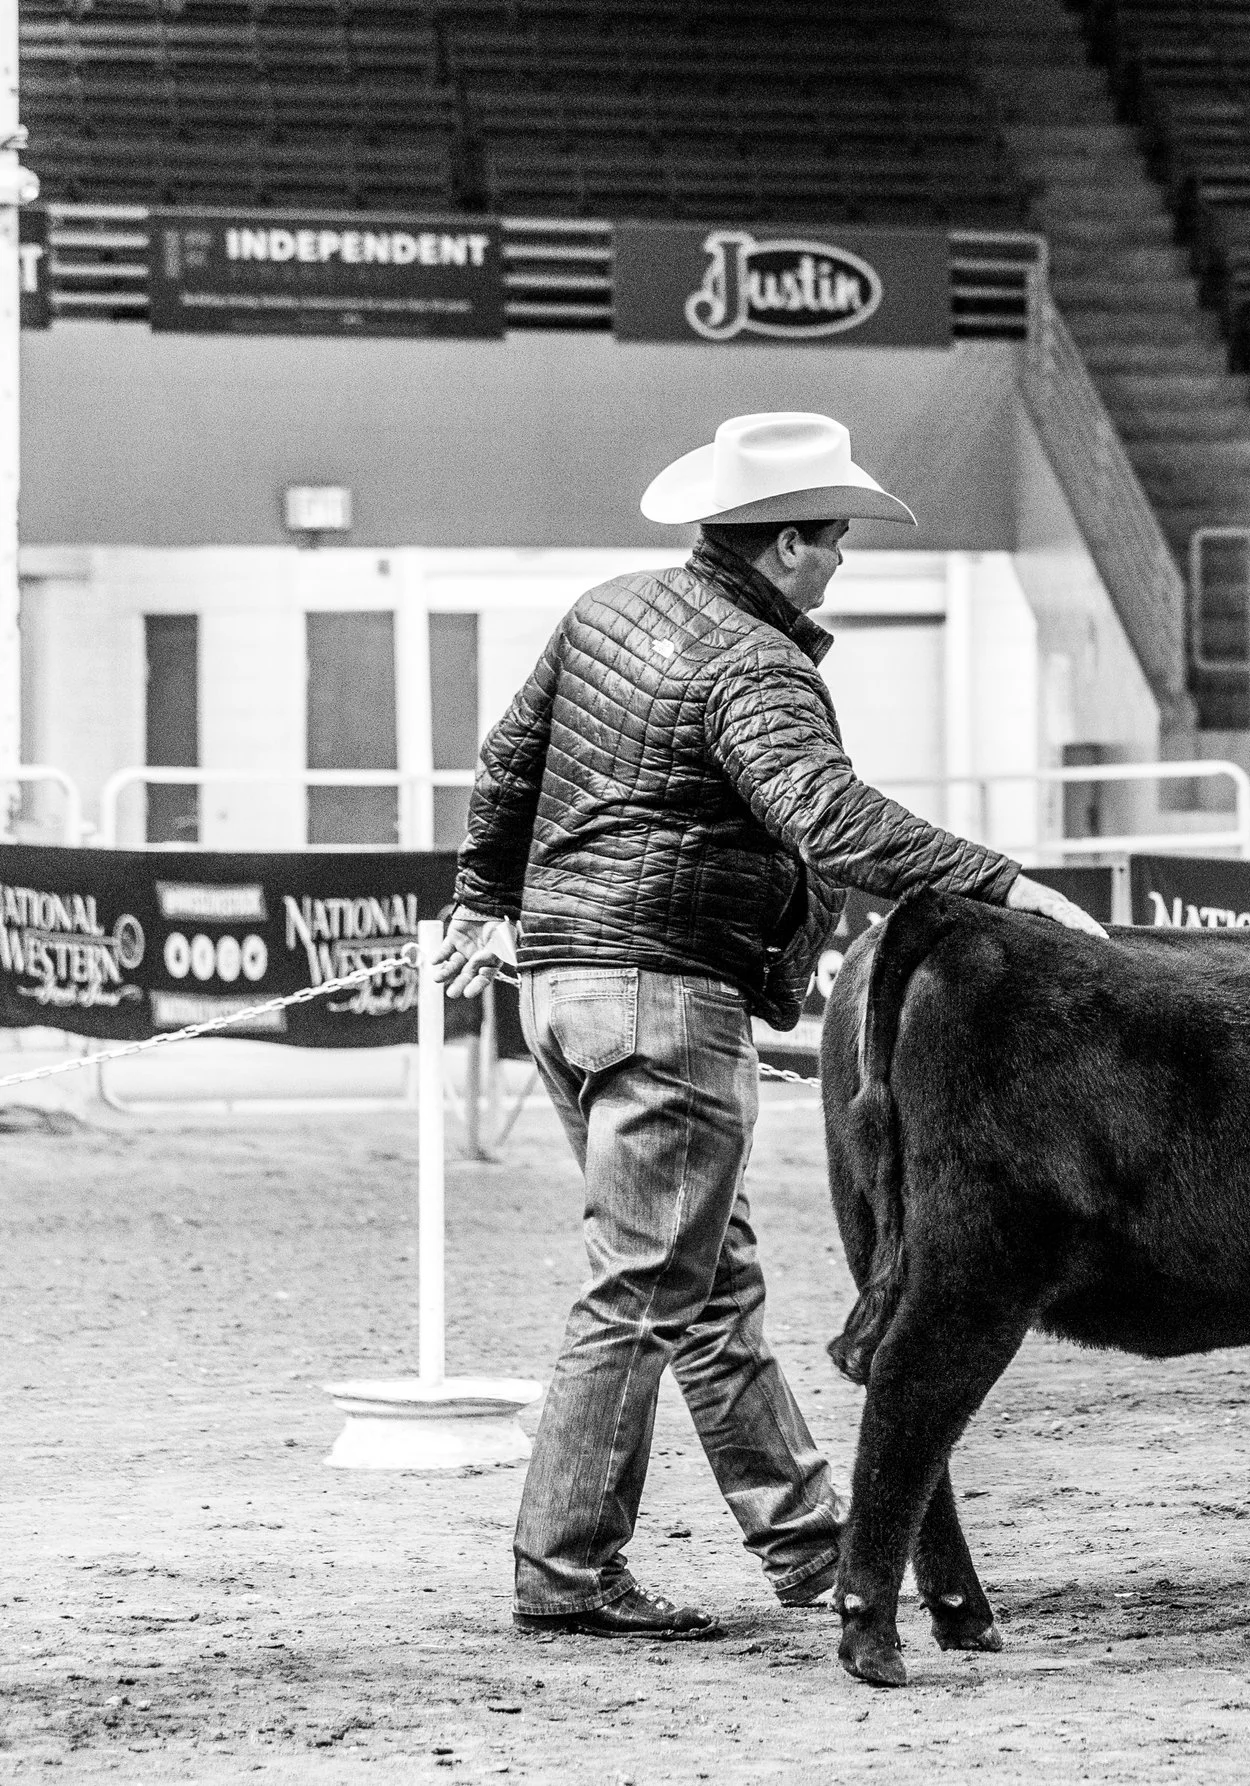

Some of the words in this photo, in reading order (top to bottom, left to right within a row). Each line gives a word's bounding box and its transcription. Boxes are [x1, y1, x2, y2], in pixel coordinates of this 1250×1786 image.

[225, 227, 490, 266] INDEPENDENT
[684, 230, 863, 340] Justin
[0, 884, 105, 936] ATIONAL
